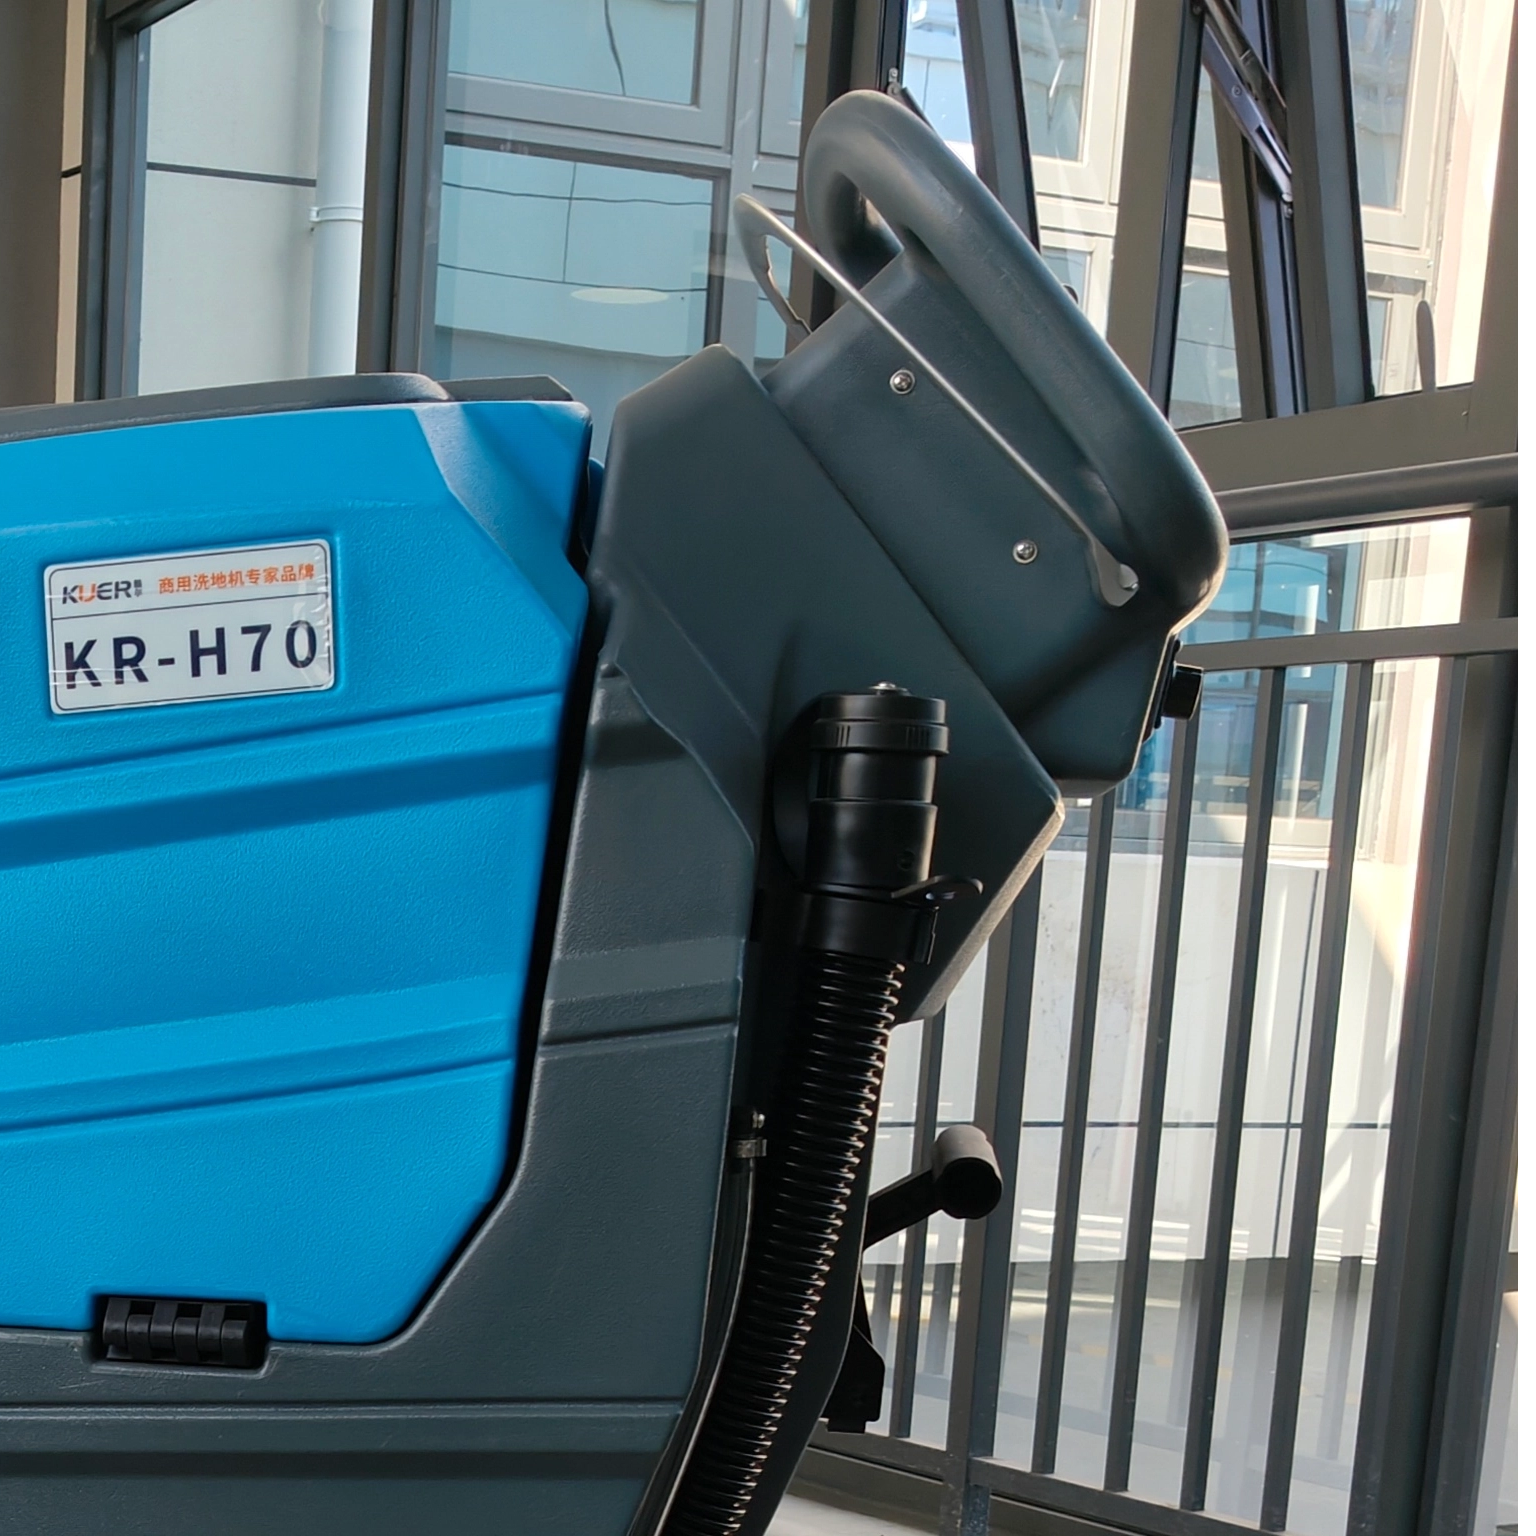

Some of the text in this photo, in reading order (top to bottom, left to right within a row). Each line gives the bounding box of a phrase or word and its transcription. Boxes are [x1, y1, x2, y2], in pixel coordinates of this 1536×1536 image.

[62, 580, 132, 604] KUER
[158, 563, 315, 594] 商用洗地机专家品牌
[63, 620, 317, 690] KR-H70
